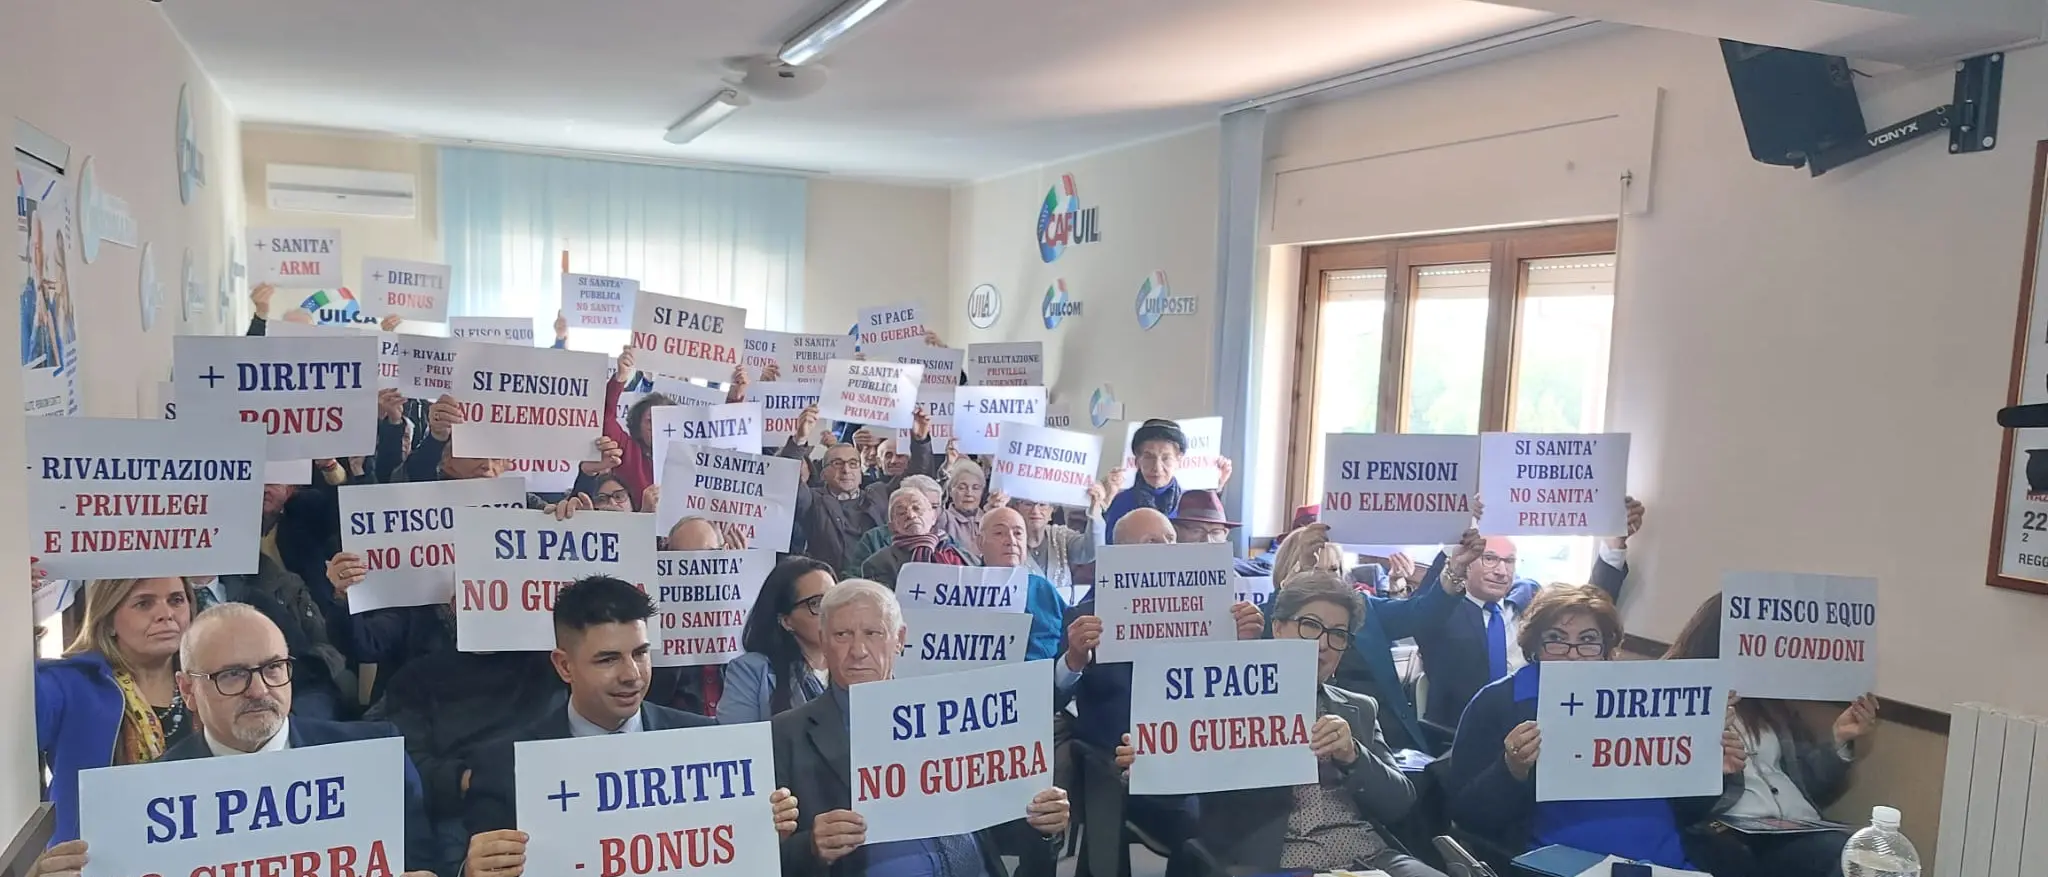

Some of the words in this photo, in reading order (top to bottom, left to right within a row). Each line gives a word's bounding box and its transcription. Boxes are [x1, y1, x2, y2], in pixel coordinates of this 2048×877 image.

[1867, 121, 1919, 147] VONYX
[271, 237, 334, 254] SANITA'
[279, 261, 321, 276] ARMI
[387, 270, 445, 290] DIRITTI
[578, 276, 587, 286] SI
[387, 291, 435, 310] BONUS
[1049, 300, 1081, 317] UILCOM
[319, 308, 378, 325] UILCA
[581, 315, 619, 325] PRIVATA
[653, 306, 671, 326] SI
[676, 311, 725, 335] PACE
[870, 314, 883, 326] SI
[885, 308, 915, 325] PACE
[505, 328, 534, 341] EQUO
[793, 337, 803, 347] SI
[861, 332, 877, 344] NO
[880, 324, 926, 343] GUERRA
[412, 348, 456, 362] RIVALU
[632, 331, 658, 352] NO
[663, 336, 737, 365] GUERRA
[743, 338, 768, 352] ISCO
[199, 365, 225, 388] +
[236, 361, 362, 391] DIRITTI
[792, 364, 804, 373] NO
[849, 365, 861, 375] SI
[413, 376, 422, 387] E
[472, 370, 493, 391] SI
[499, 372, 590, 398] PENSIONI
[847, 378, 898, 394] PUBBLICA
[841, 390, 856, 401] NO
[458, 402, 485, 422] NO
[490, 404, 600, 428] ELEMOSINA
[844, 405, 890, 421] PRIVATA
[962, 400, 975, 412] +
[979, 399, 1038, 414] SANITA'
[663, 422, 676, 437] +
[683, 417, 752, 439] SANITA'
[1008, 440, 1023, 454] SI
[1025, 446, 1087, 466] PENSIONI
[1515, 440, 1531, 455] SI
[1535, 440, 1598, 456] SANITA'
[41, 456, 252, 481] RIVALUTAZIONE
[695, 452, 709, 466] SI
[712, 454, 770, 475] SANITA'
[996, 460, 1014, 474] NO
[1017, 464, 1093, 487] ELEMOSINA
[1341, 461, 1360, 480] SI
[1366, 461, 1459, 482] PENSIONI
[1516, 464, 1594, 480] PUBBLICA
[694, 474, 764, 497] PUBBLICA
[1510, 488, 1532, 504] NO
[1536, 487, 1599, 504] SANITA'
[75, 494, 209, 517] PRIVILEGI
[687, 494, 706, 510] NO
[710, 498, 768, 518] SANITA'
[1325, 492, 1352, 511] NO
[1359, 492, 1470, 513] ELEMOSINA
[351, 512, 376, 535] SI
[383, 507, 454, 533] FISCO
[1518, 512, 1588, 527] PRIVATA
[2023, 510, 2048, 531] 22
[43, 531, 61, 553] E
[70, 526, 220, 553] INDENNITA'
[495, 529, 527, 561] SI
[538, 531, 619, 563] PACE
[2022, 532, 2029, 542] 2
[367, 548, 401, 571] NO
[657, 559, 673, 576] SI
[678, 558, 743, 576] SANITA'
[1098, 575, 1109, 589] +
[1114, 570, 1227, 589] RIVALUTAZIONE
[462, 579, 508, 612] NO
[659, 584, 741, 602] PUBBLICA
[909, 584, 926, 600] +
[933, 583, 1018, 607] SANITA'
[1131, 596, 1204, 614] PRIVILEGI
[1730, 595, 1752, 619] SI
[1757, 597, 1819, 624] FISCO
[1825, 601, 1876, 628] EQUO
[681, 609, 746, 628] SANITA'
[1116, 625, 1125, 640] E
[1129, 621, 1213, 640] INDENNITA'
[663, 636, 737, 656] PRIVATA
[921, 632, 1015, 661] SANITA'
[1738, 633, 1767, 657] NO
[1774, 635, 1865, 662] CONDONI
[1165, 667, 1194, 701] SI
[1203, 663, 1279, 698] PACE
[1560, 692, 1584, 716] +
[1594, 686, 1712, 719] DIRITTI
[893, 703, 926, 741] SI
[937, 689, 1018, 736] PACE
[1136, 721, 1178, 755] NO
[1189, 714, 1310, 753] GUERRA
[1591, 735, 1692, 768] BONUS
[858, 763, 906, 801] NO
[920, 740, 1048, 796] GUERRA
[548, 780, 580, 812] +
[595, 759, 756, 812] DIRITTI
[147, 794, 198, 844] SI
[215, 775, 346, 836] PACE
[600, 824, 736, 877] BONUS
